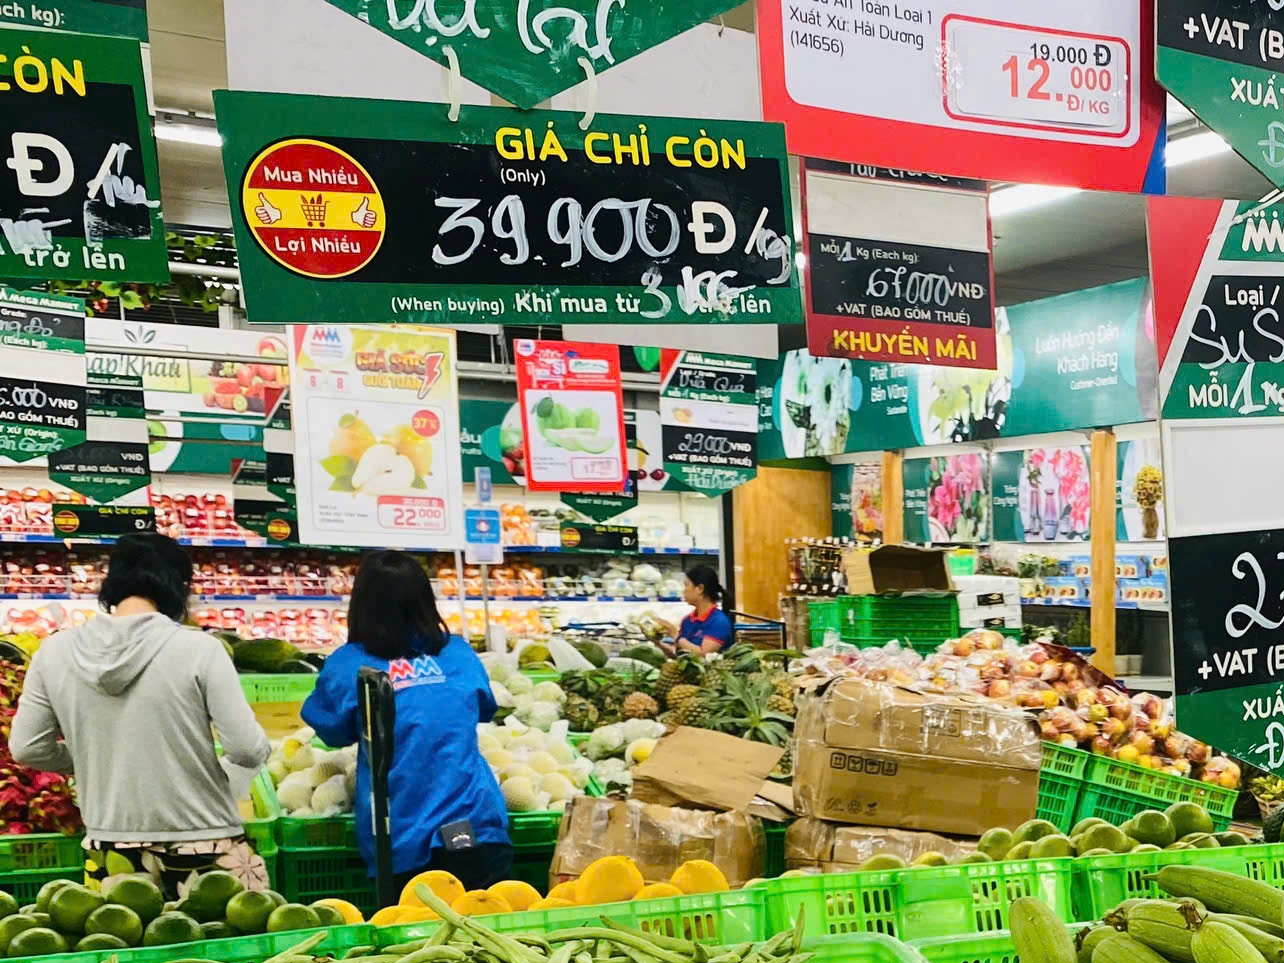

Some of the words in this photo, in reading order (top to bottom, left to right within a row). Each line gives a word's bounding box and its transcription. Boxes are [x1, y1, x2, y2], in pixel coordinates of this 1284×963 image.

[0, 2, 25, 18] ch
[31, 5, 66, 27] kg):
[928, 11, 932, 24] 1
[789, 5, 821, 27] Xuất
[854, 19, 875, 37] Hải
[880, 25, 924, 50] Dương
[1184, 13, 1249, 50] +VAT
[790, 30, 844, 58] (141656)
[1029, 43, 1087, 65] 19.000
[0, 46, 86, 96] ÒN
[1088, 101, 1111, 115] KG
[494, 120, 569, 163] GIÁ
[584, 123, 651, 167] CHỈ
[665, 132, 747, 171] CÒN
[263, 166, 303, 184] Mua
[308, 167, 359, 186] Nhiều
[499, 167, 547, 186] (Only)
[83, 246, 125, 270] lên
[275, 236, 304, 258] Lợi
[312, 238, 361, 254] Nhiều
[872, 246, 900, 262] (Each
[949, 281, 985, 300] VNĐ
[1224, 284, 1264, 308] Loại
[391, 297, 445, 314] (When
[448, 297, 505, 316] buying)
[515, 292, 554, 314] Khi
[560, 297, 606, 314] mua
[614, 293, 640, 314] từ
[740, 295, 771, 314] lên
[836, 301, 867, 316] +VAT
[871, 303, 902, 320] (BAO
[904, 302, 932, 322] GỒM
[935, 306, 970, 326] THUẾ)
[833, 327, 929, 357] KHUYẾN
[935, 337, 977, 361] MÃI
[1188, 371, 1228, 409] MỖI
[48, 397, 79, 410] VNĐ
[1197, 648, 1258, 680] +VAT
